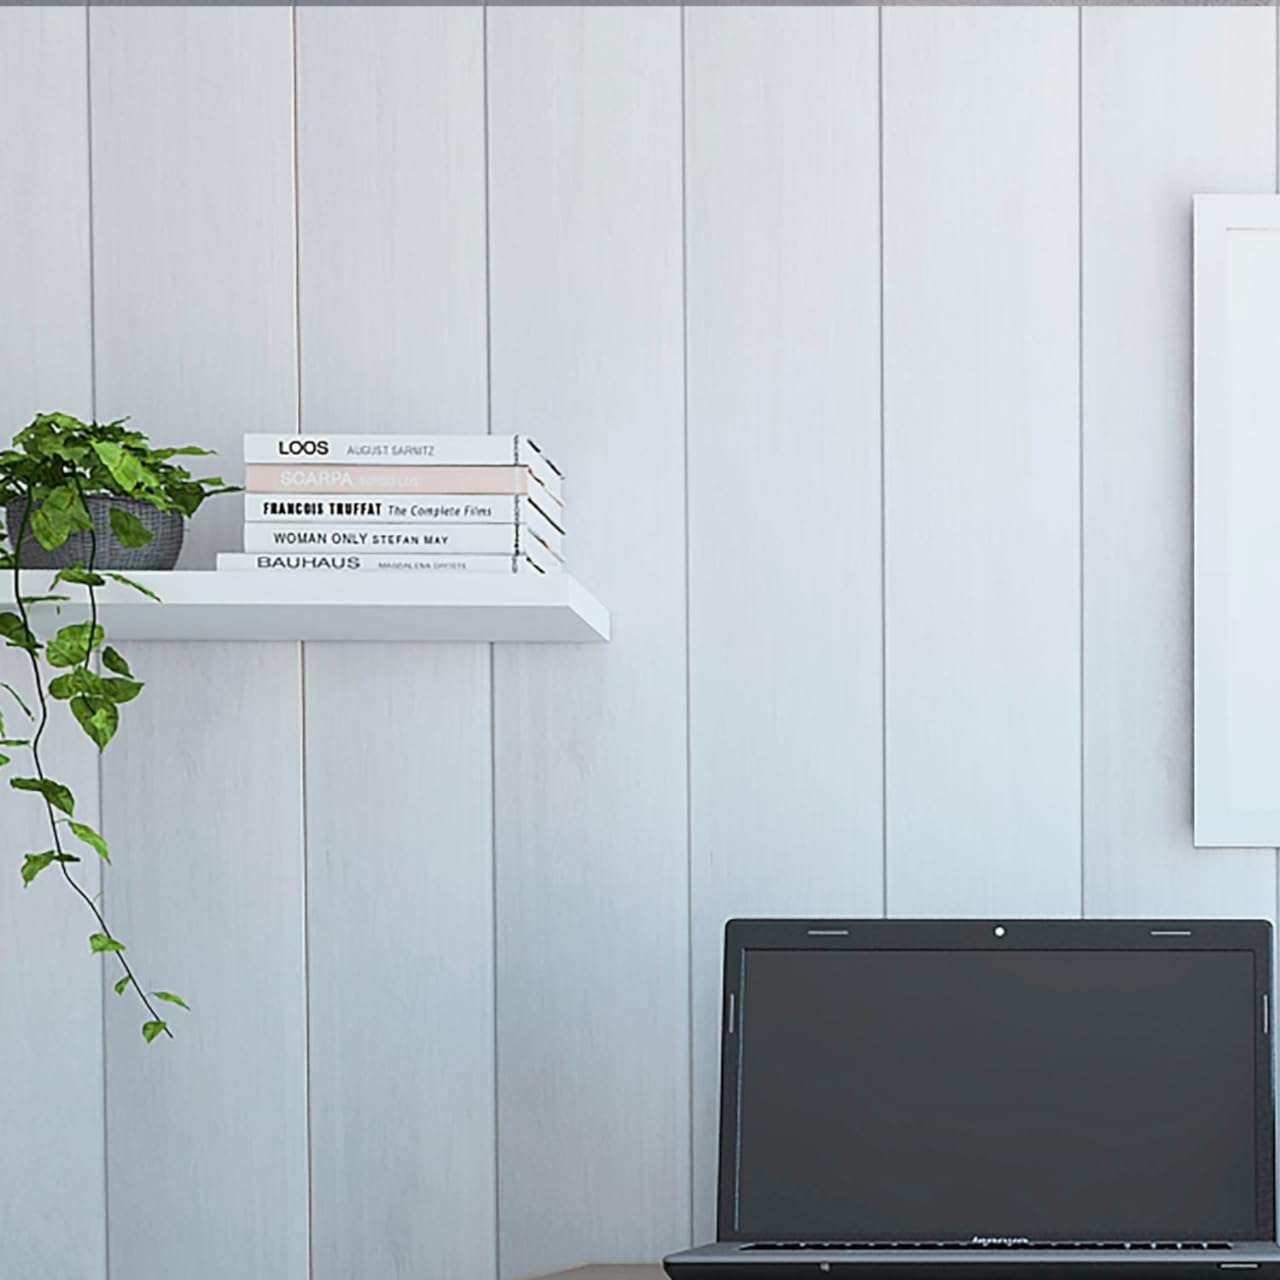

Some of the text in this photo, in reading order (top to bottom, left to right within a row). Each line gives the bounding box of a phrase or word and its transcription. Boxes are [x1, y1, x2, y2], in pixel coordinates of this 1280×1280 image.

[278, 440, 329, 455] LOOS
[280, 470, 352, 487] SCARPA
[263, 502, 492, 519] FRANCOIS TRUFFAT The Complete Films
[273, 532, 449, 545] WOMAN ONLY STEFAN MAY
[257, 556, 361, 569] BAUHAUS
